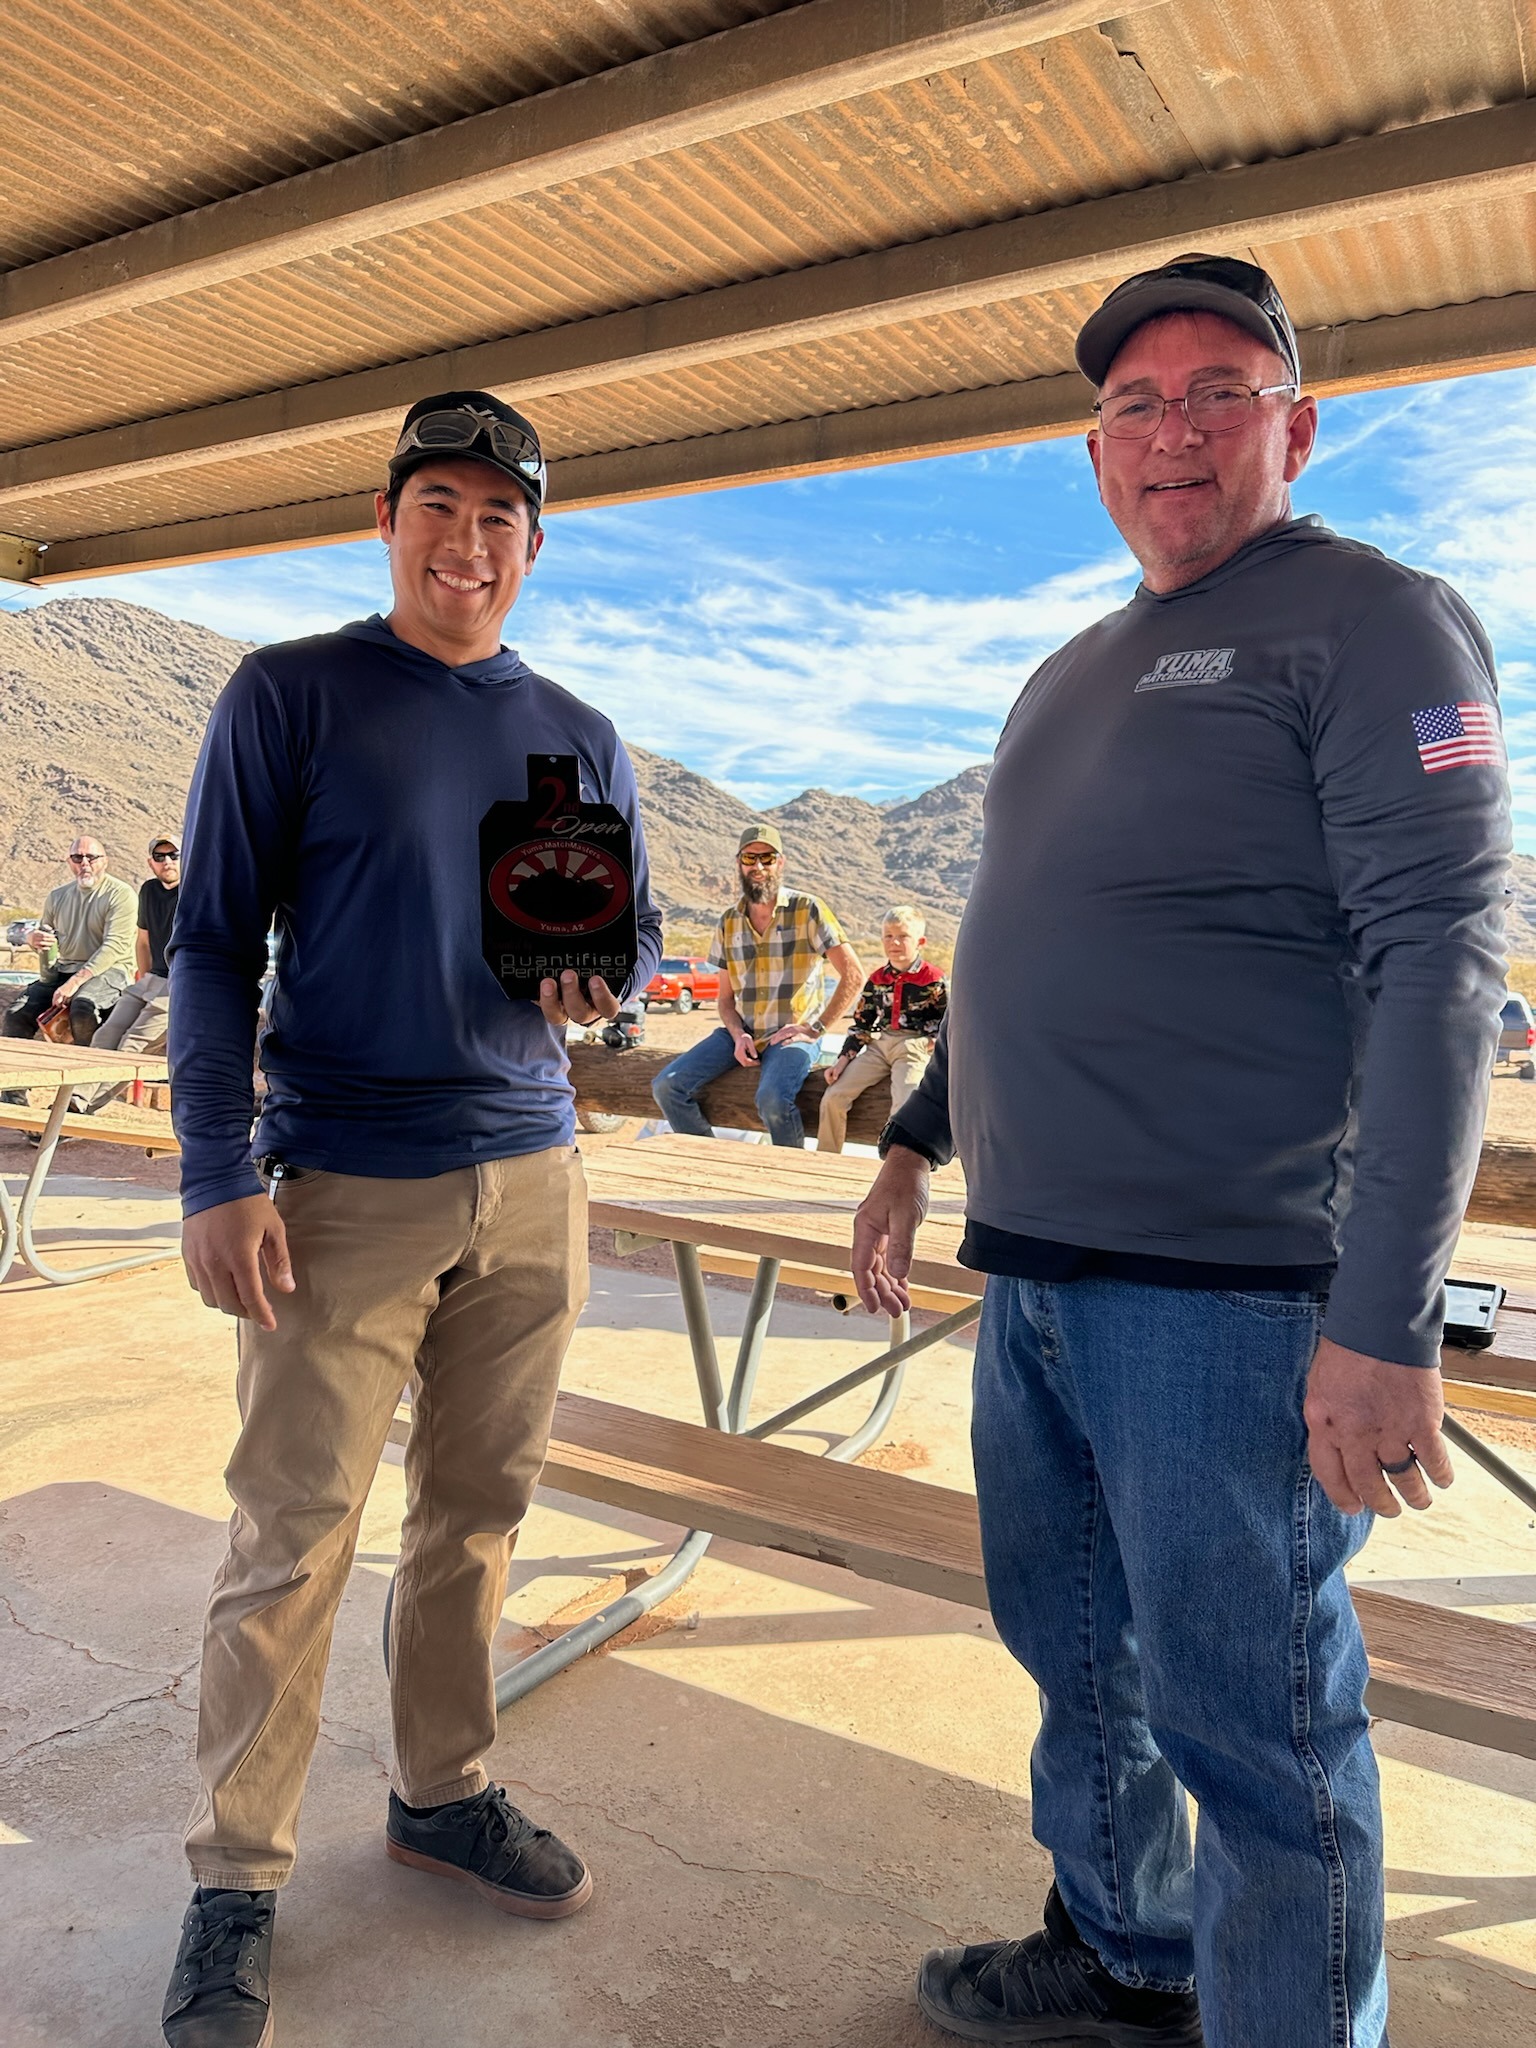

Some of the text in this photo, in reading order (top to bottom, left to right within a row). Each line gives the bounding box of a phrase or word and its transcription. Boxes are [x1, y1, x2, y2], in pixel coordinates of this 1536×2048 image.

[1153, 650, 1232, 674] YUMA
[1141, 669, 1229, 684] MATCHMASTERS
[552, 815, 624, 839] Open
[520, 844, 544, 856] Yuma
[540, 923, 585, 933] Yuma, AZ
[500, 953, 627, 967] Quantified
[500, 966, 627, 978] Perforance
